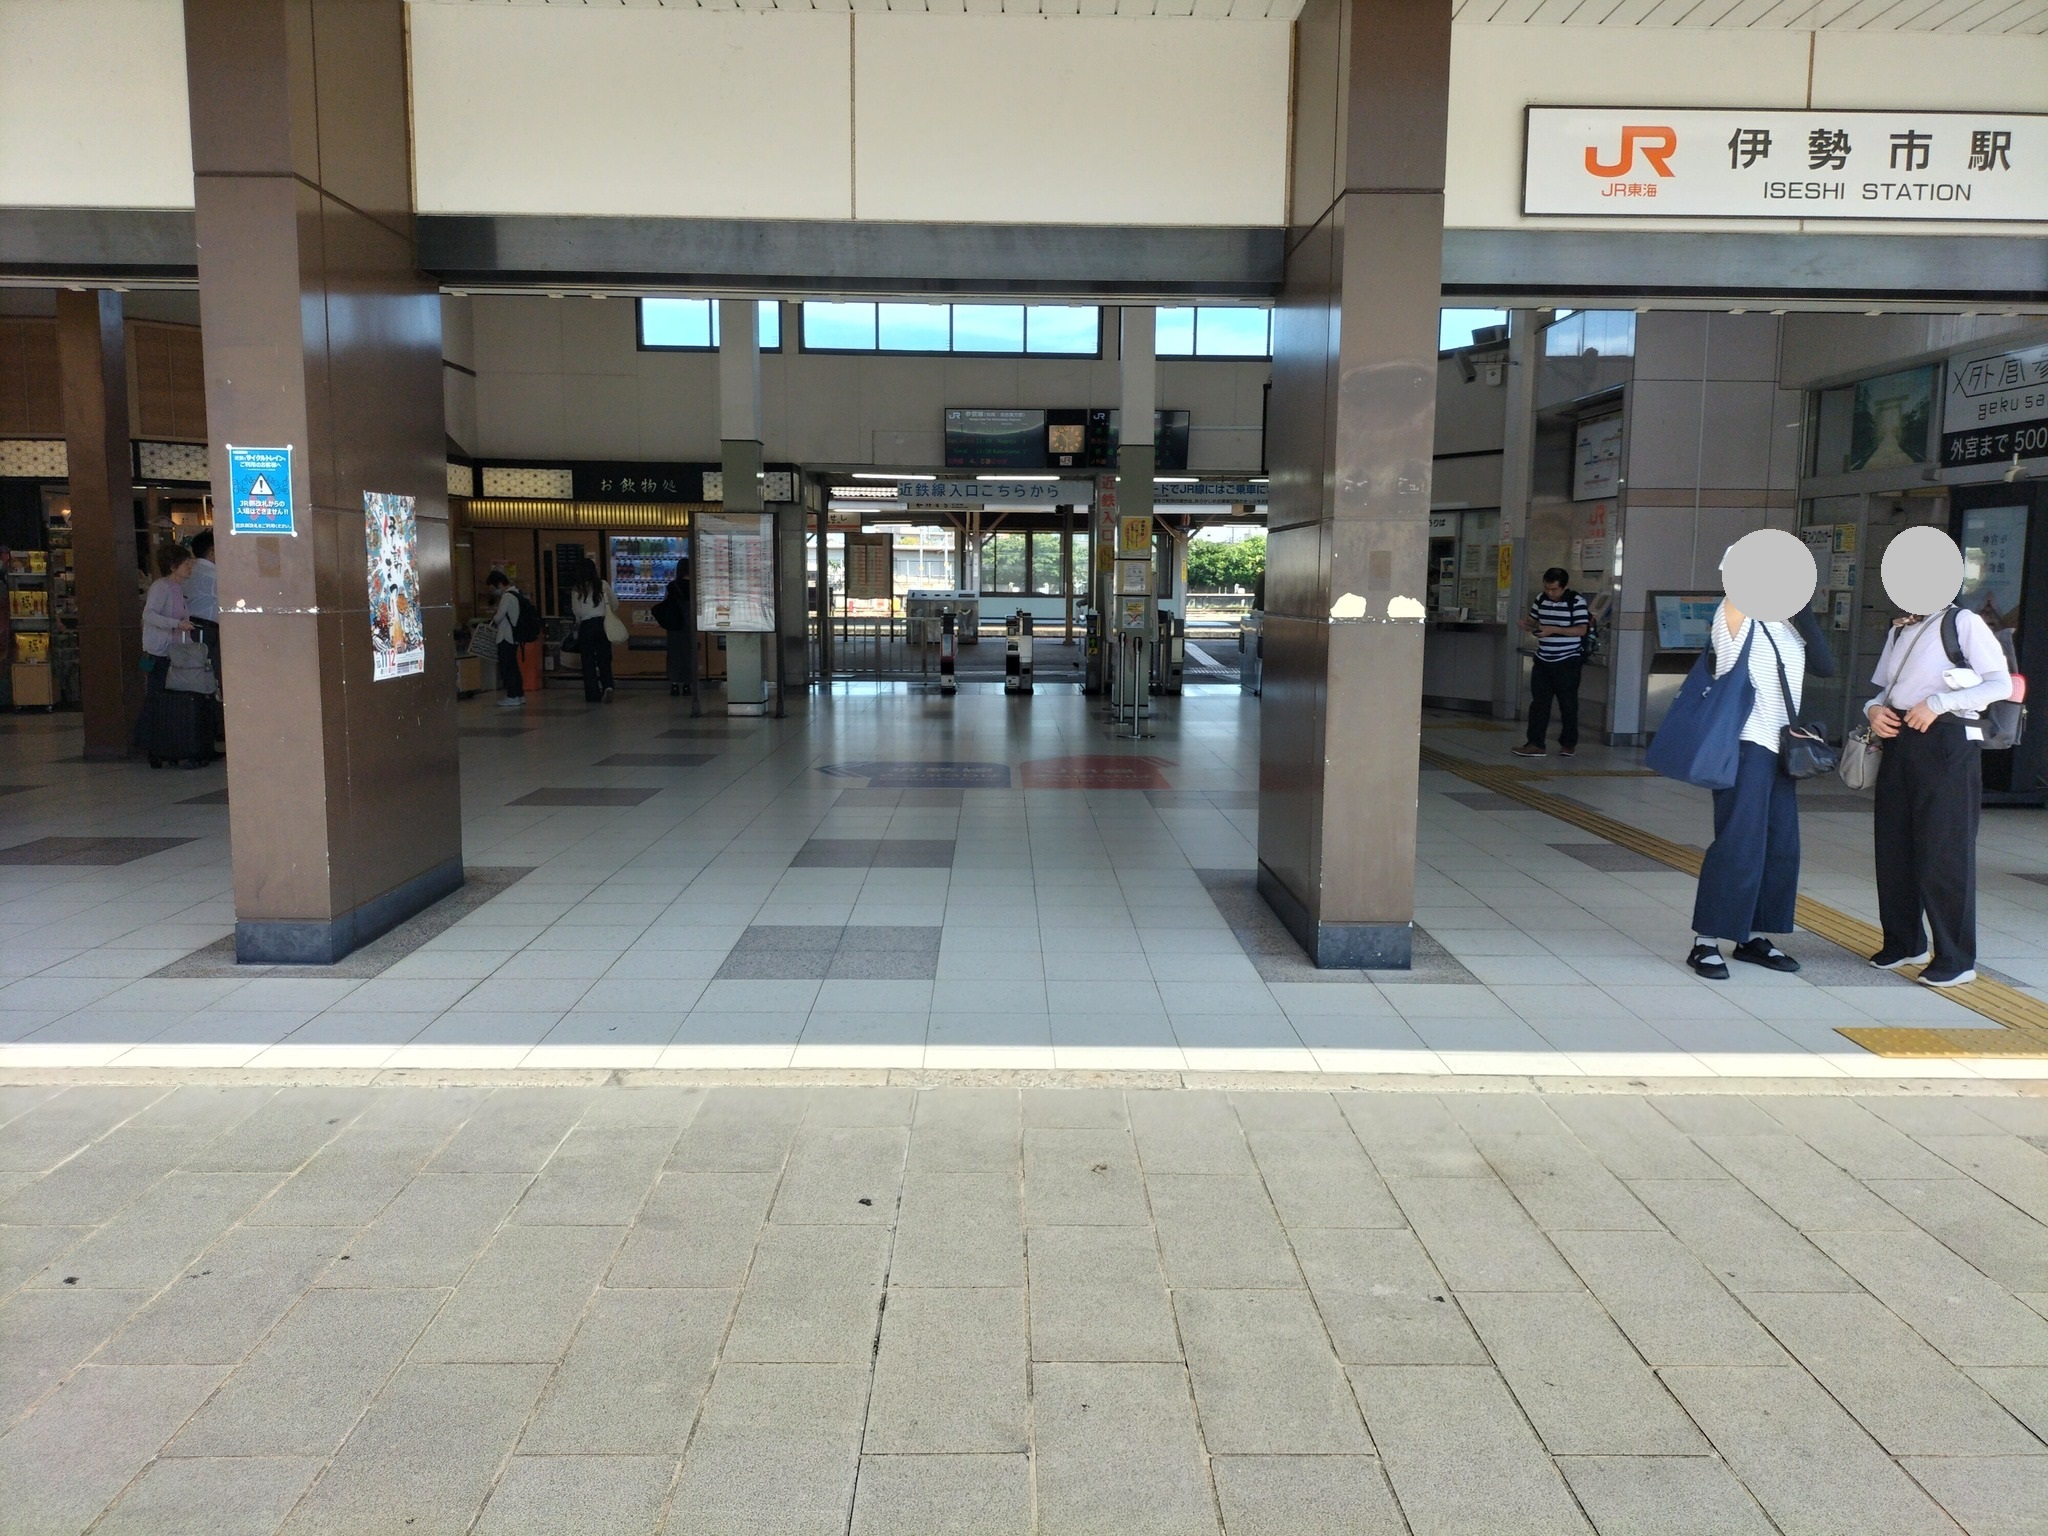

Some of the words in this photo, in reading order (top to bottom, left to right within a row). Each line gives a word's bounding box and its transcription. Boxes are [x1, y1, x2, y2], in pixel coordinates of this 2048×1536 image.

[1585, 126, 1677, 178] JR
[1728, 127, 2012, 172] 伊勢市駅
[1601, 182, 1658, 198] JR東海
[1763, 181, 1846, 200] ISESHI
[1862, 182, 1972, 202] STATION
[948, 411, 961, 420] JR
[1093, 412, 1106, 420] JR
[600, 477, 678, 493] お飲物処
[899, 482, 1060, 498] 近鉄線入口こちらから
[1101, 475, 1116, 542] 近鉄入口
